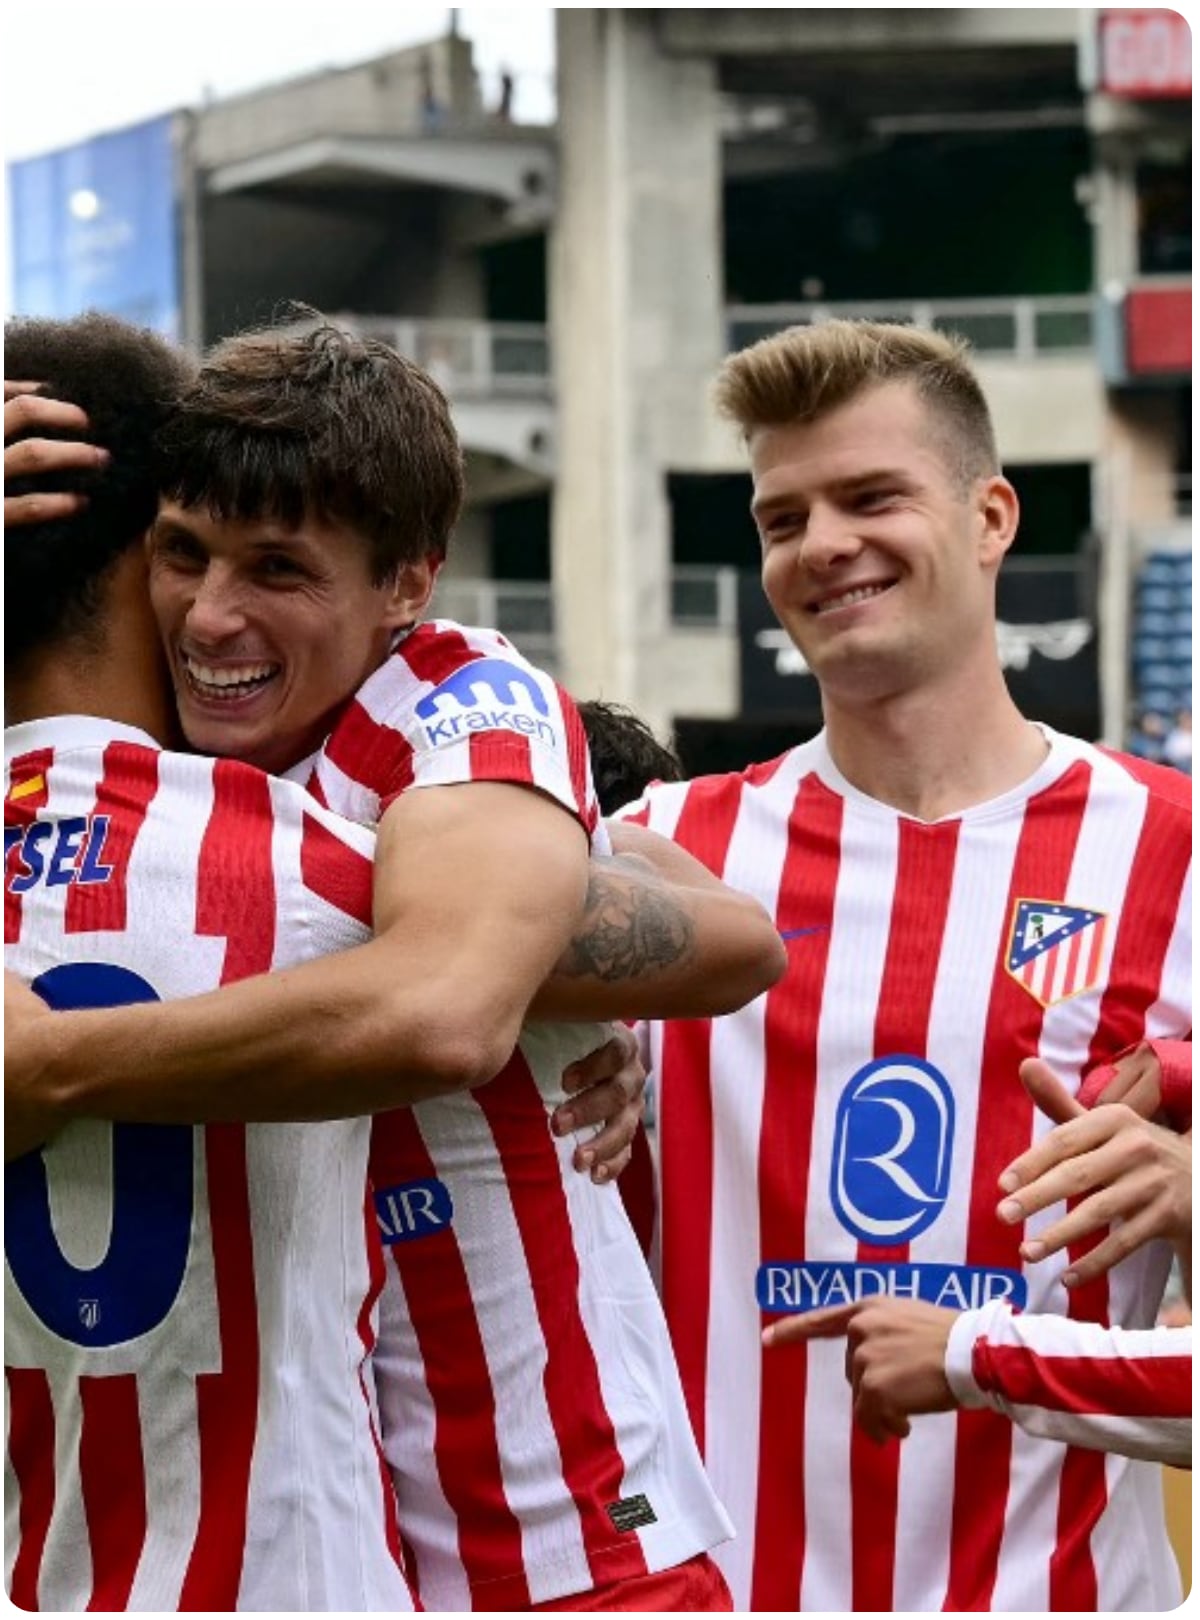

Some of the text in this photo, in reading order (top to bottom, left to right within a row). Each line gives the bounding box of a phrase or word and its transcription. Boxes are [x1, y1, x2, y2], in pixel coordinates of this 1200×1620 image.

[1104, 22, 1191, 86] GO
[426, 711, 556, 747] kraken
[376, 1187, 442, 1236] IR
[766, 1267, 921, 1306] RIYADH
